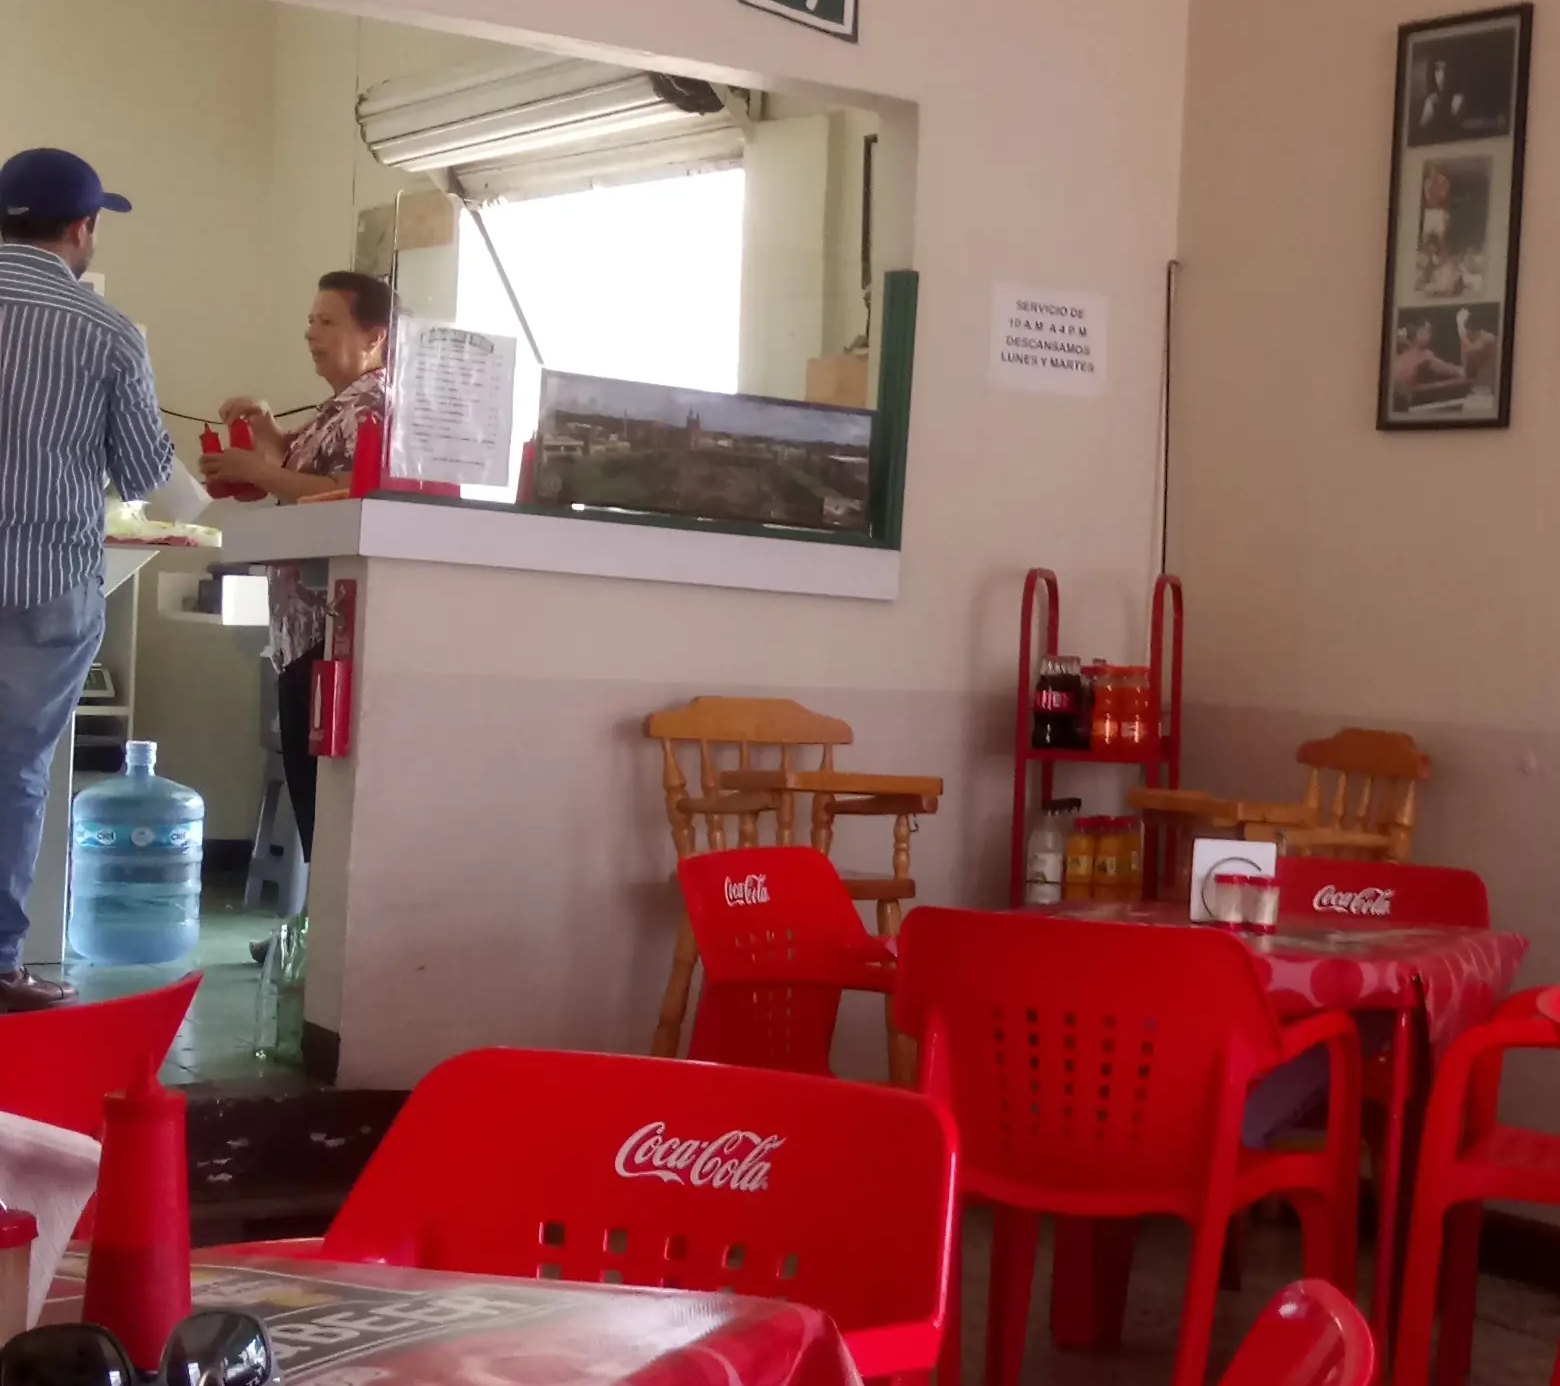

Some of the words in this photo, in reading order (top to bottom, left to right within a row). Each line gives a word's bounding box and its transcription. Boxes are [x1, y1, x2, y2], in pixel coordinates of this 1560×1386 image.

[1016, 299, 1068, 317] SERVICIO
[1070, 307, 1085, 319] DE
[1006, 335, 1091, 356] DESCANSAMOS
[1001, 351, 1038, 366] LUNES
[1040, 356, 1048, 368] Y
[1050, 357, 1095, 373] MARTES
